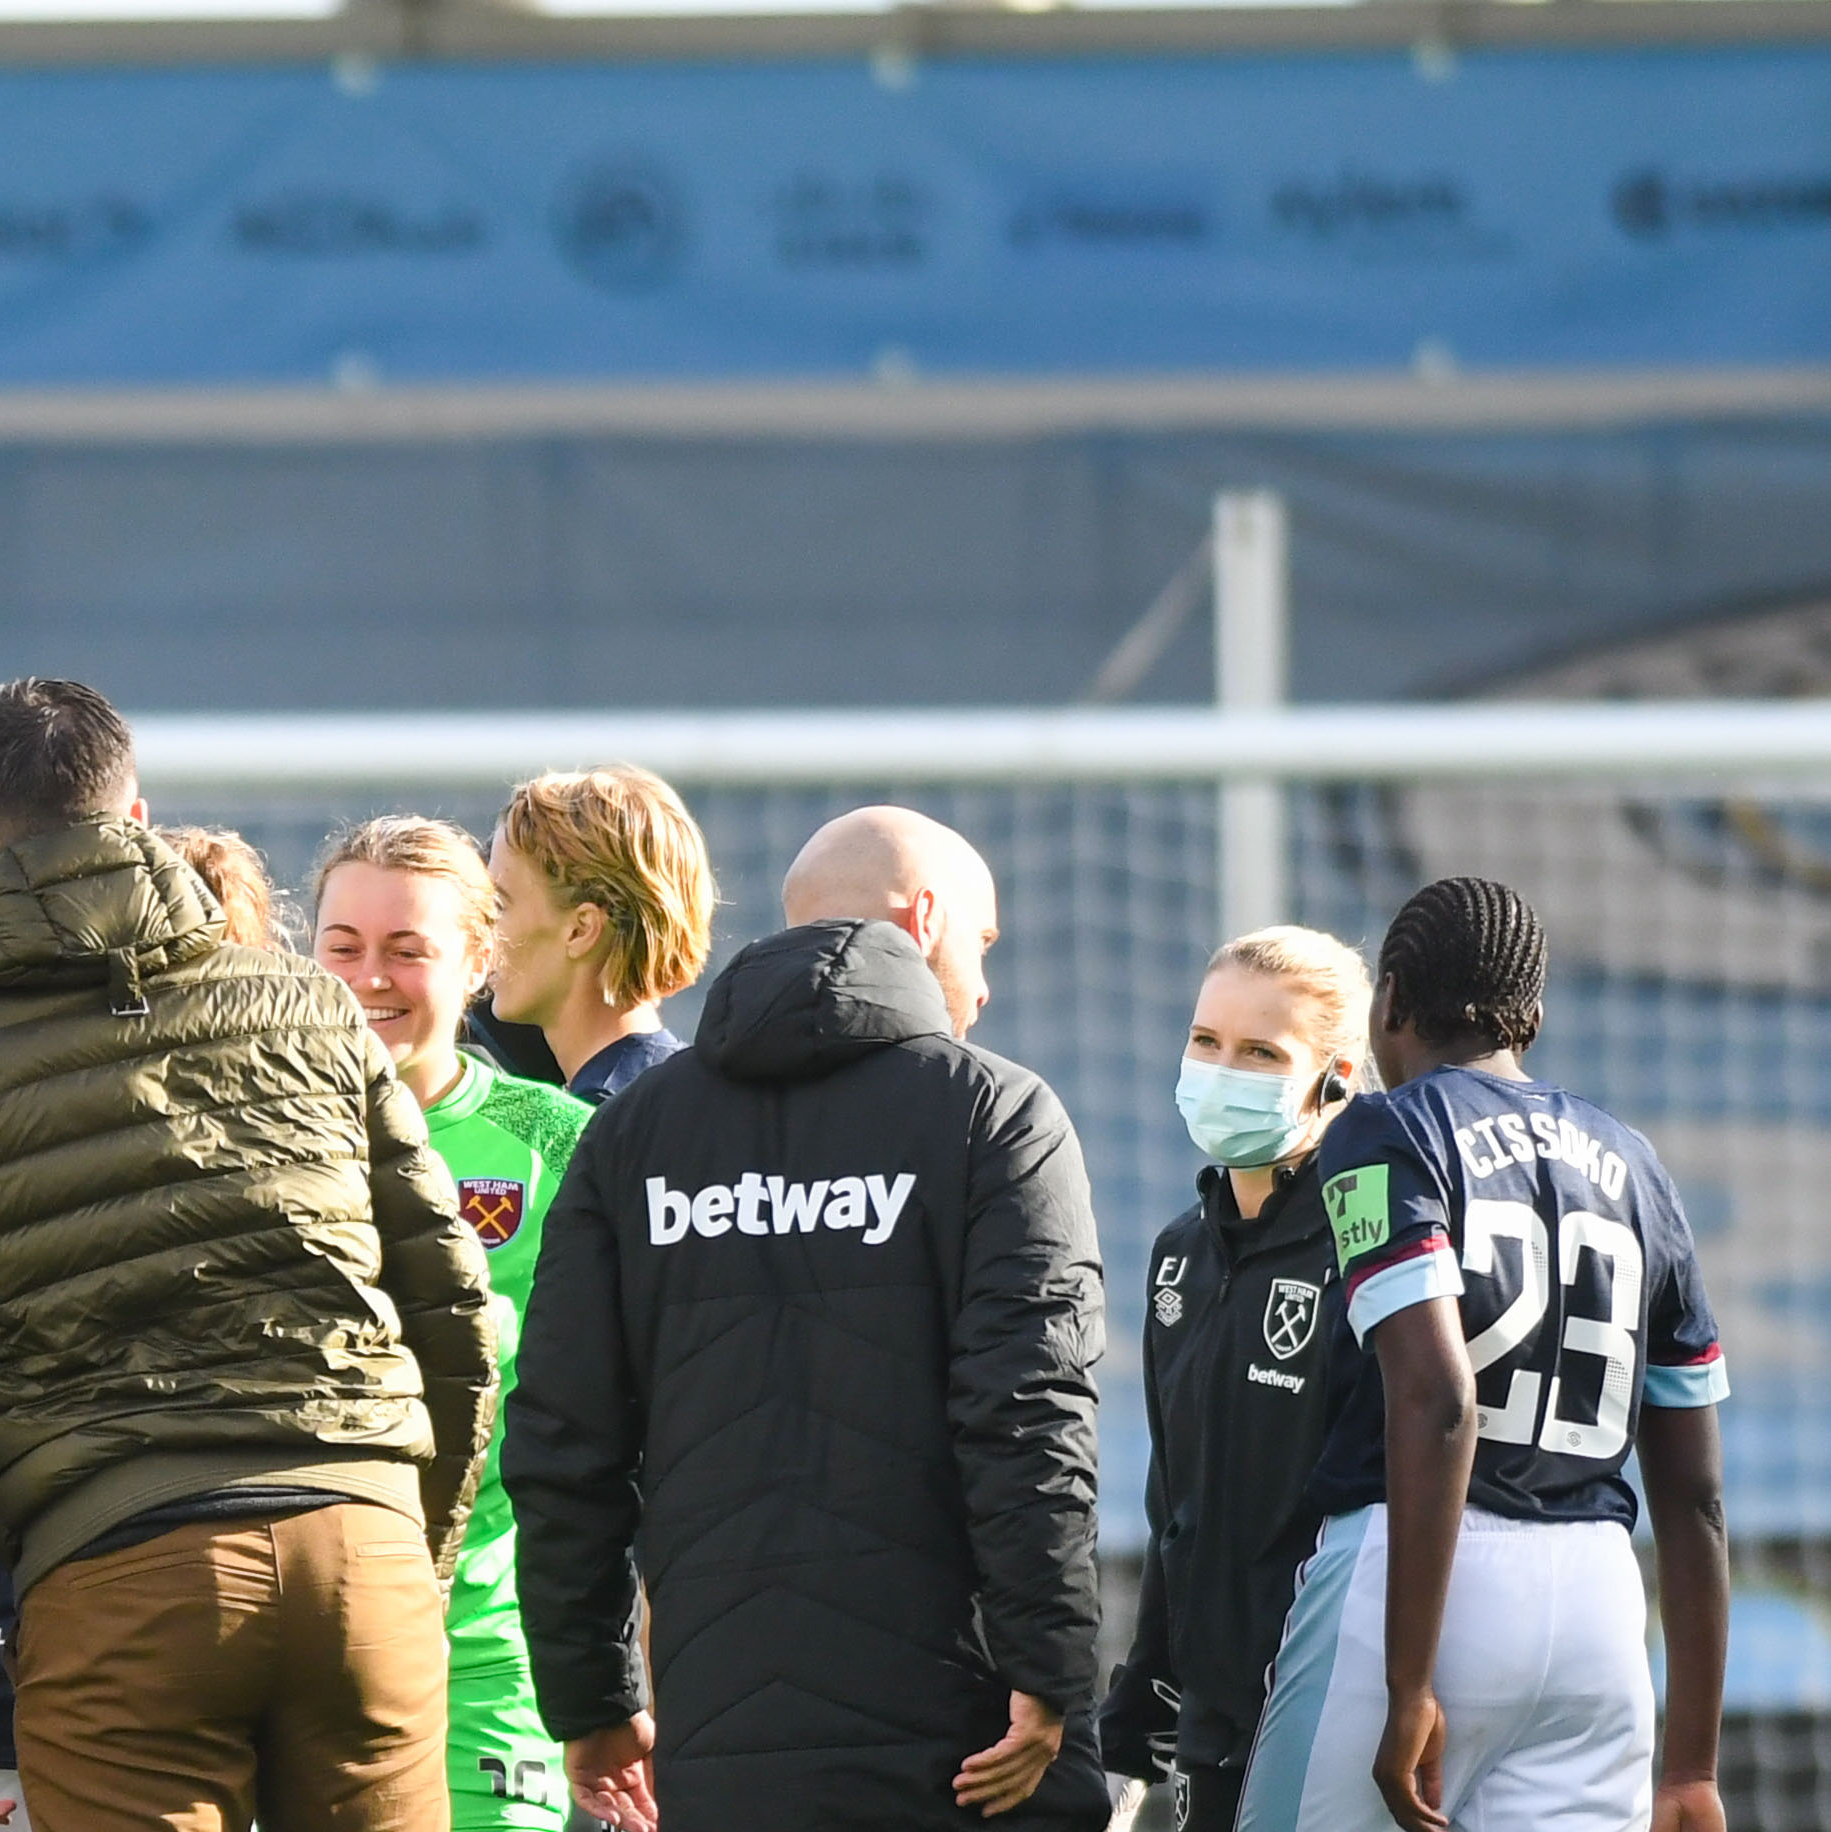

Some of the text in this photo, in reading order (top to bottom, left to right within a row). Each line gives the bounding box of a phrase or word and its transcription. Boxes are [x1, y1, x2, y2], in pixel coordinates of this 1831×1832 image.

[1455, 1112, 1628, 1201] CISSOKO
[645, 1171, 917, 1246] betway
[1340, 1217, 1384, 1248] stly
[1462, 1198, 1645, 1460] 23
[1247, 1363, 1305, 1395] betway
